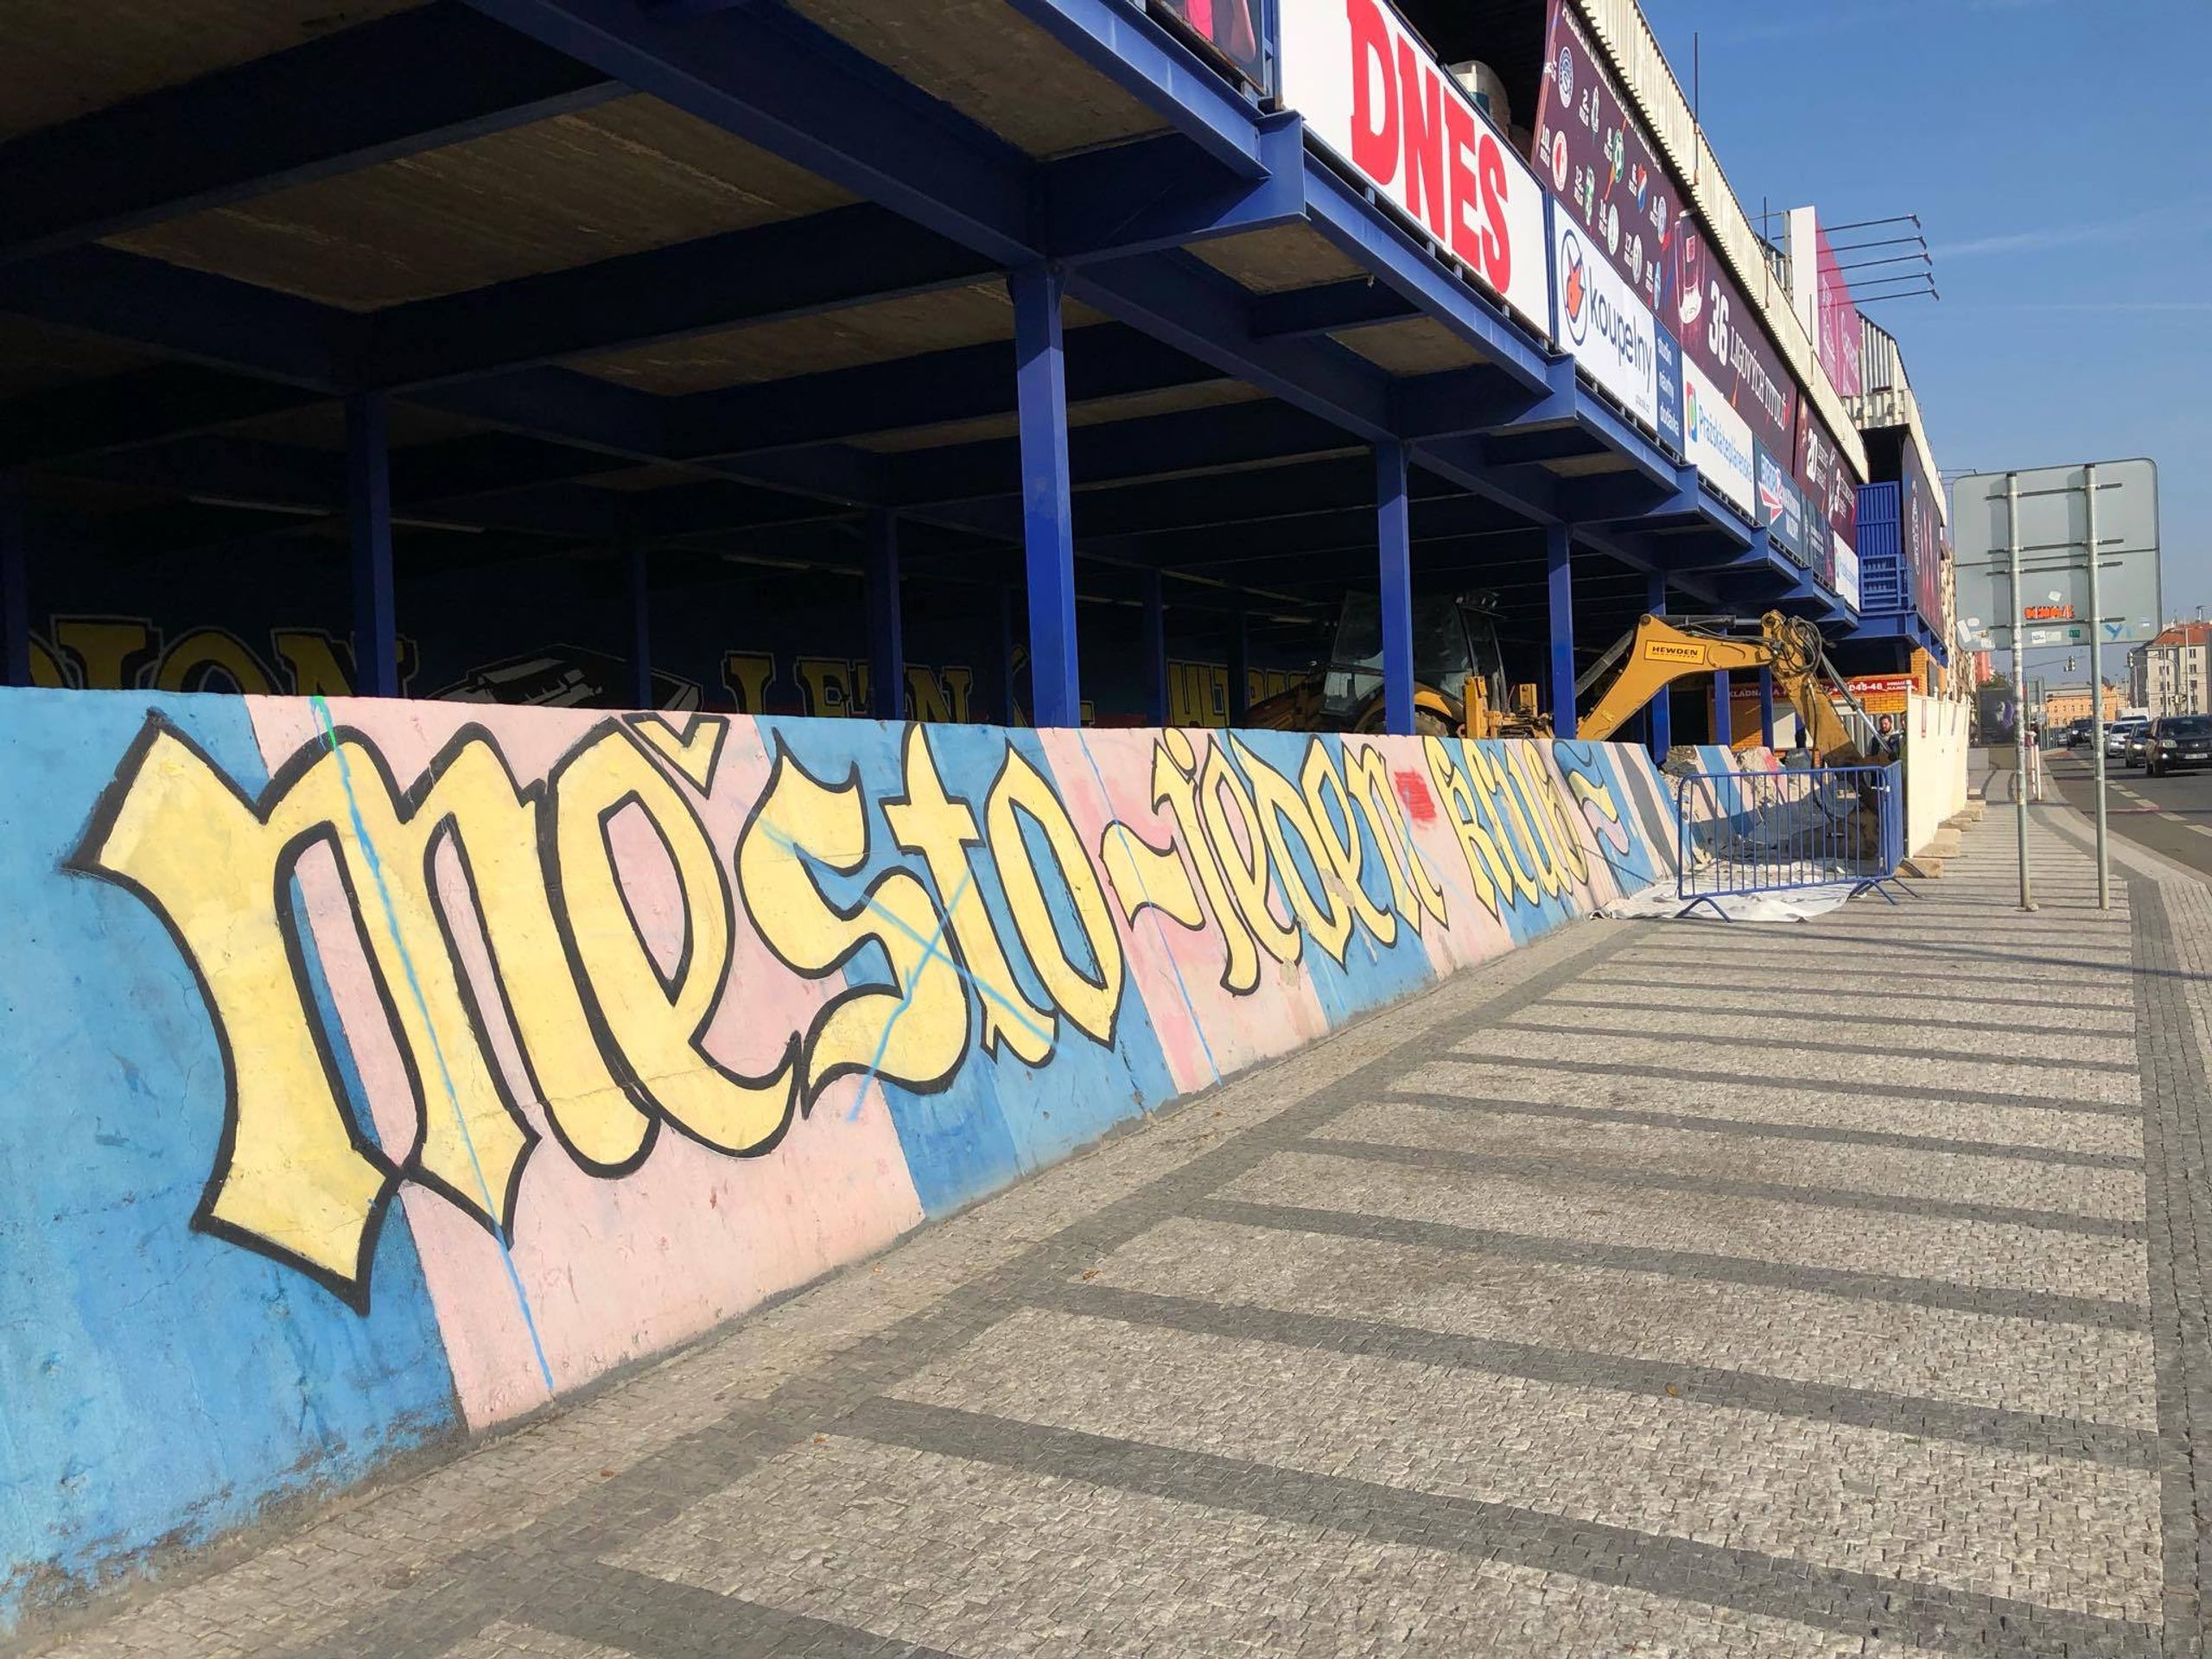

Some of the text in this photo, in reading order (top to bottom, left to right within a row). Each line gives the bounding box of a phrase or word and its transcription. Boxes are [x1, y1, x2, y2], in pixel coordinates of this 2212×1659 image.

[1346, 0, 1510, 294] DNES
[1588, 264, 1652, 393] koupelny
[1708, 279, 1729, 367] 36
[1652, 646, 1698, 656] HEWDEN
